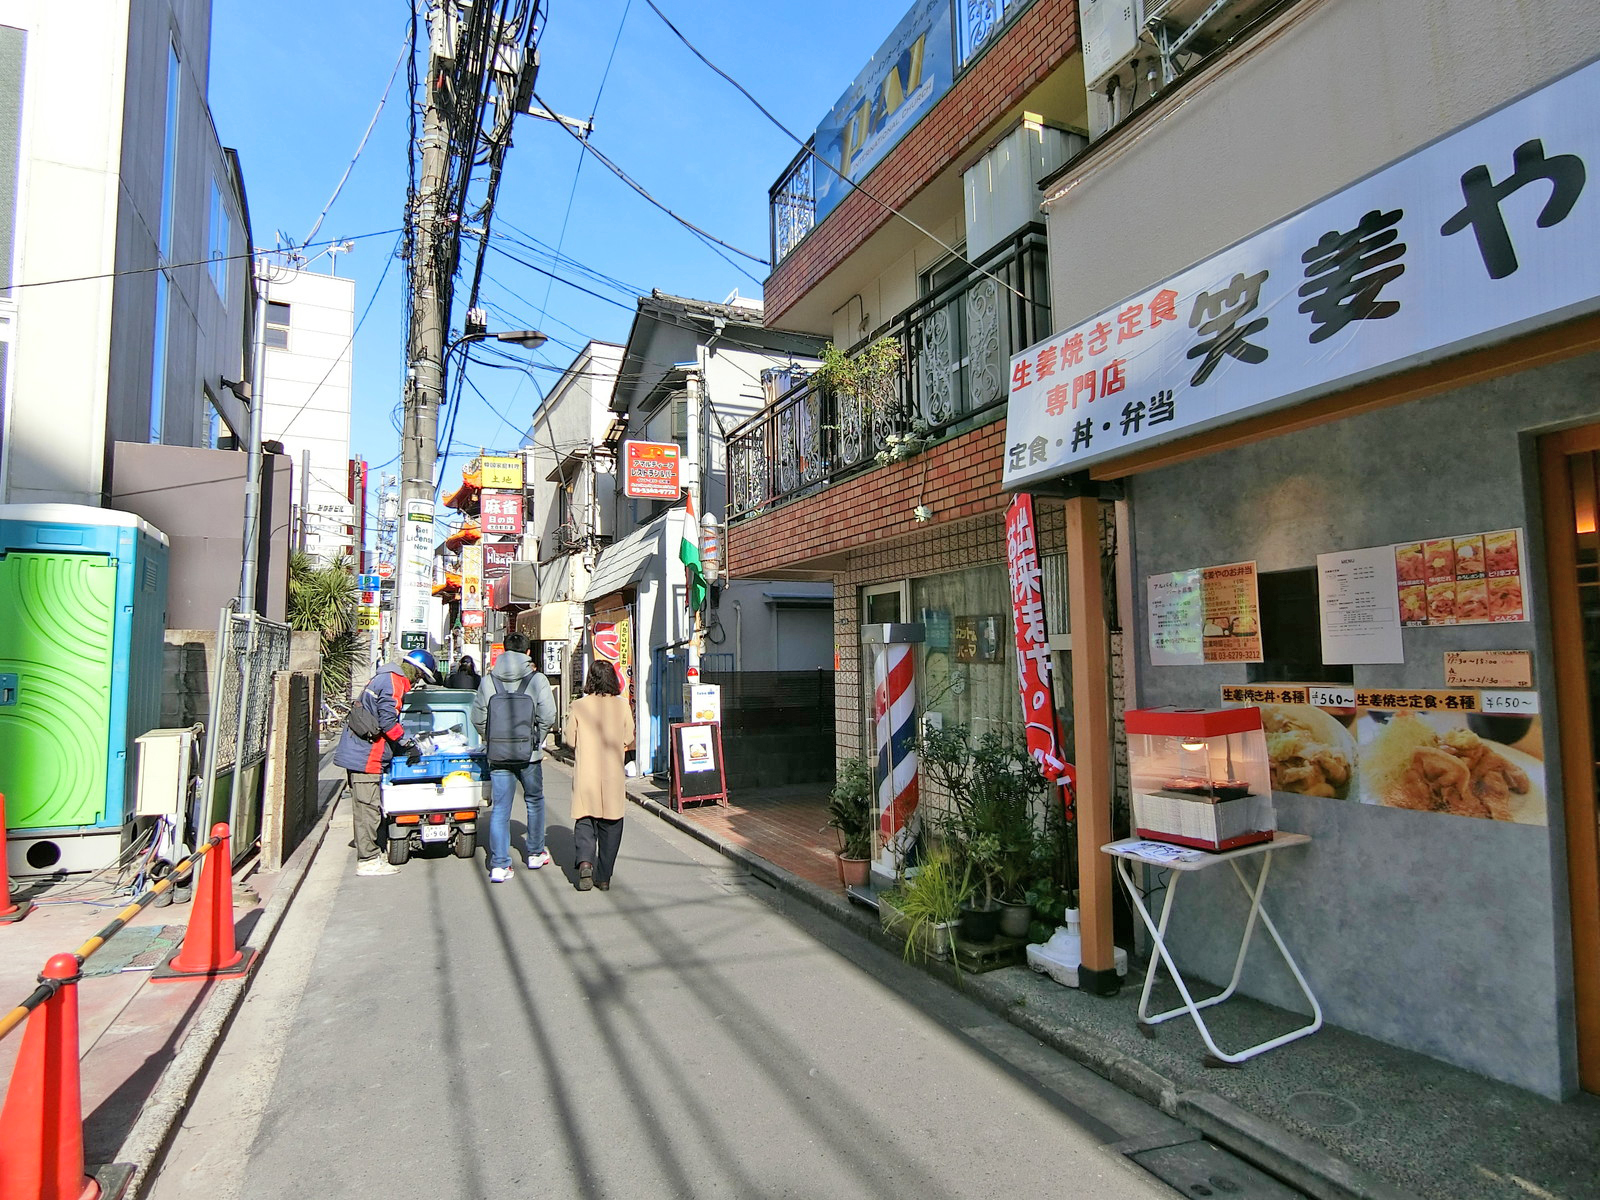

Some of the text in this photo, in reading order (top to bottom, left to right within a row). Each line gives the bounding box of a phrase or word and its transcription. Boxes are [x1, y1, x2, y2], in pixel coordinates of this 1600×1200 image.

[853, 80, 931, 172] INTERNATIONAL CHURCH
[1187, 138, 1586, 387] 笑姜や
[1011, 289, 1178, 393] 生姜焼き定食
[1045, 359, 1127, 416] 専門店
[484, 499, 518, 514] 麻雀
[488, 516, 514, 524] 日の出
[957, 644, 977, 657] パーマ
[1223, 689, 1305, 704] 生姜焼き丼・各種
[1357, 694, 1476, 709] 生姜焼き定食・各種
